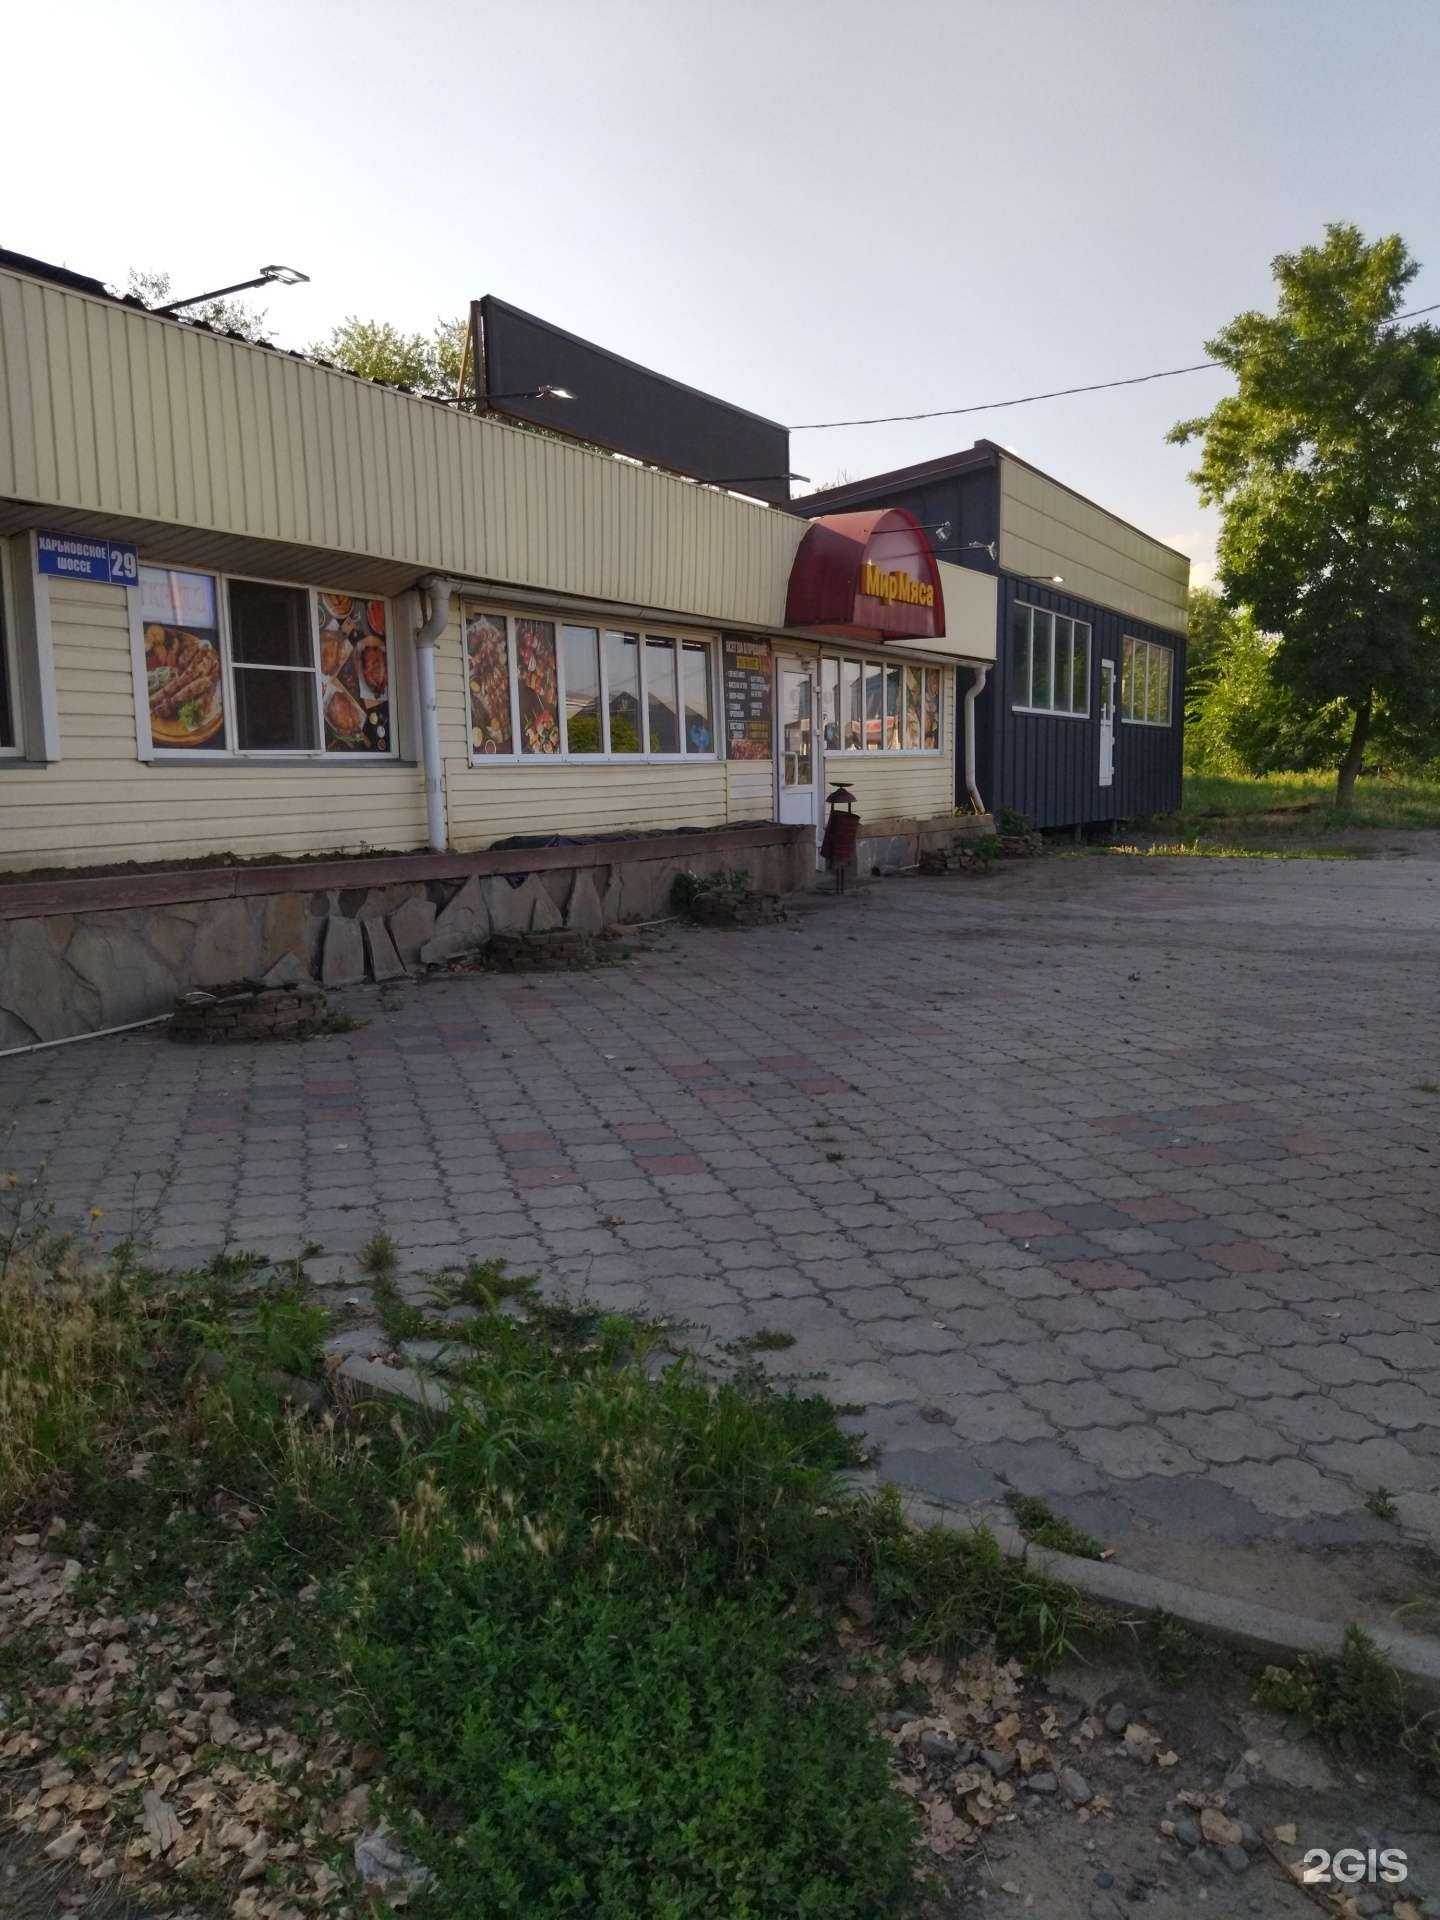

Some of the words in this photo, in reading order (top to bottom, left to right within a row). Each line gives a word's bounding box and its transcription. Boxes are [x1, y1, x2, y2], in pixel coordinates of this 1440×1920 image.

[39, 536, 107, 559] ХАРЬКОВСКОЕ
[57, 556, 92, 573] ШОССЕ
[110, 550, 137, 578] 29
[864, 564, 898, 605] Мир
[898, 573, 934, 607] Мяса
